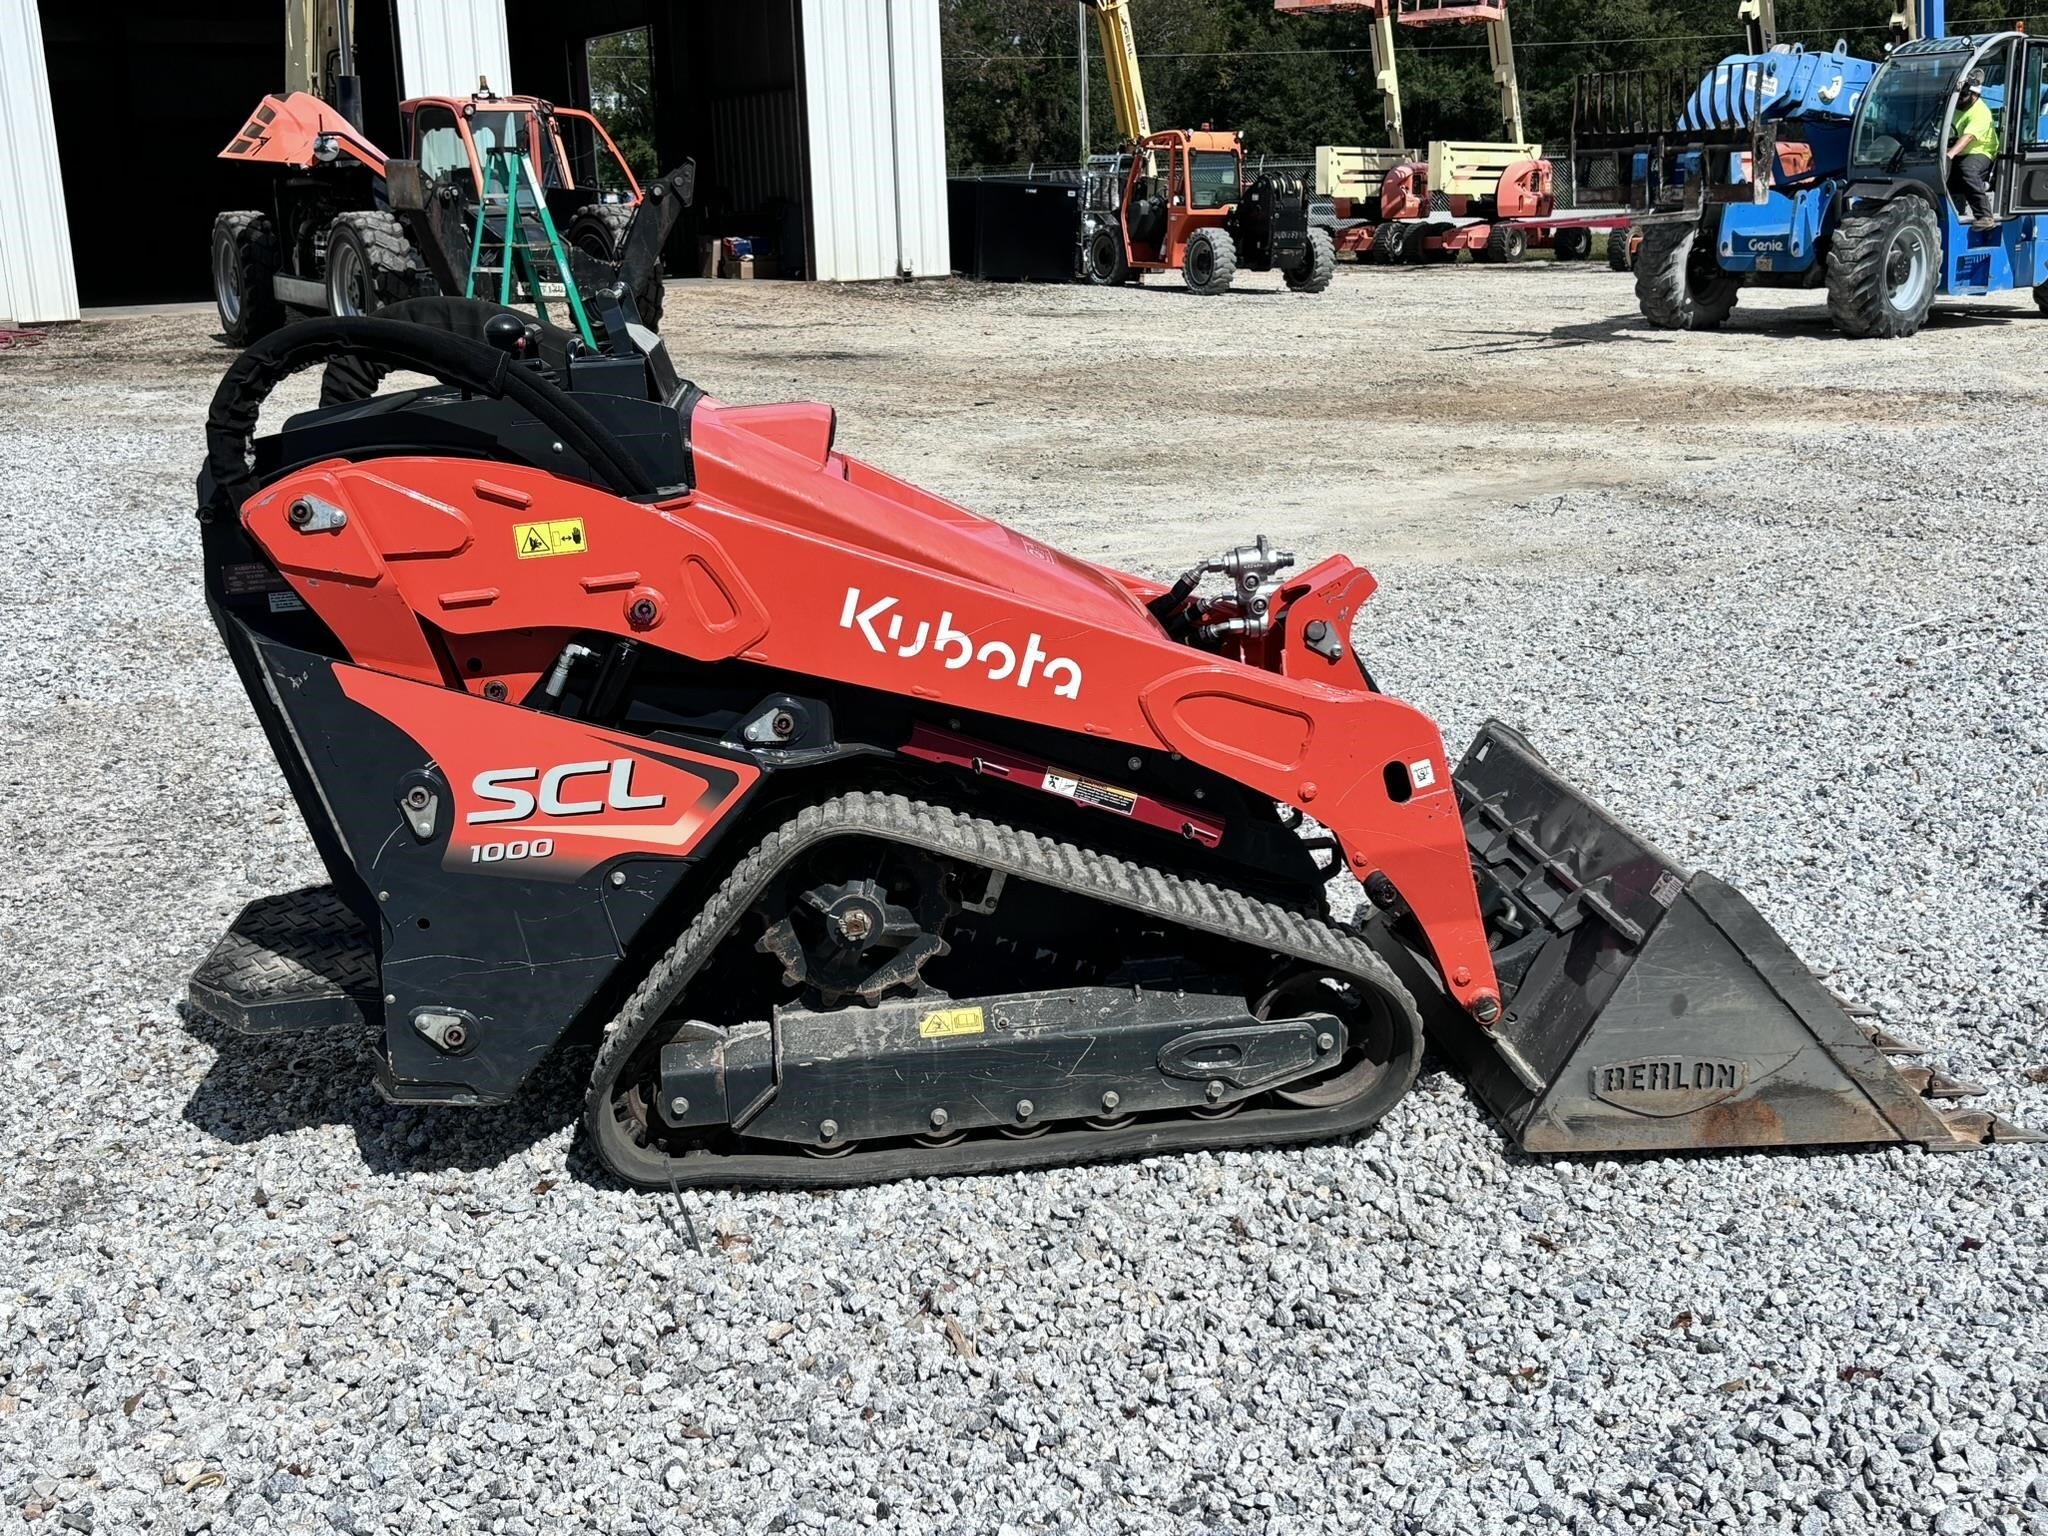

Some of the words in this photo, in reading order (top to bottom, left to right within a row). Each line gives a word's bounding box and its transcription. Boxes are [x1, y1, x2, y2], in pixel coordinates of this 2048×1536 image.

[1748, 238, 1784, 251] Genie
[840, 587, 1082, 700] Kubota
[466, 758, 666, 826] SCL
[470, 838, 554, 864] 1000
[1603, 1062, 1736, 1092] BERLON
